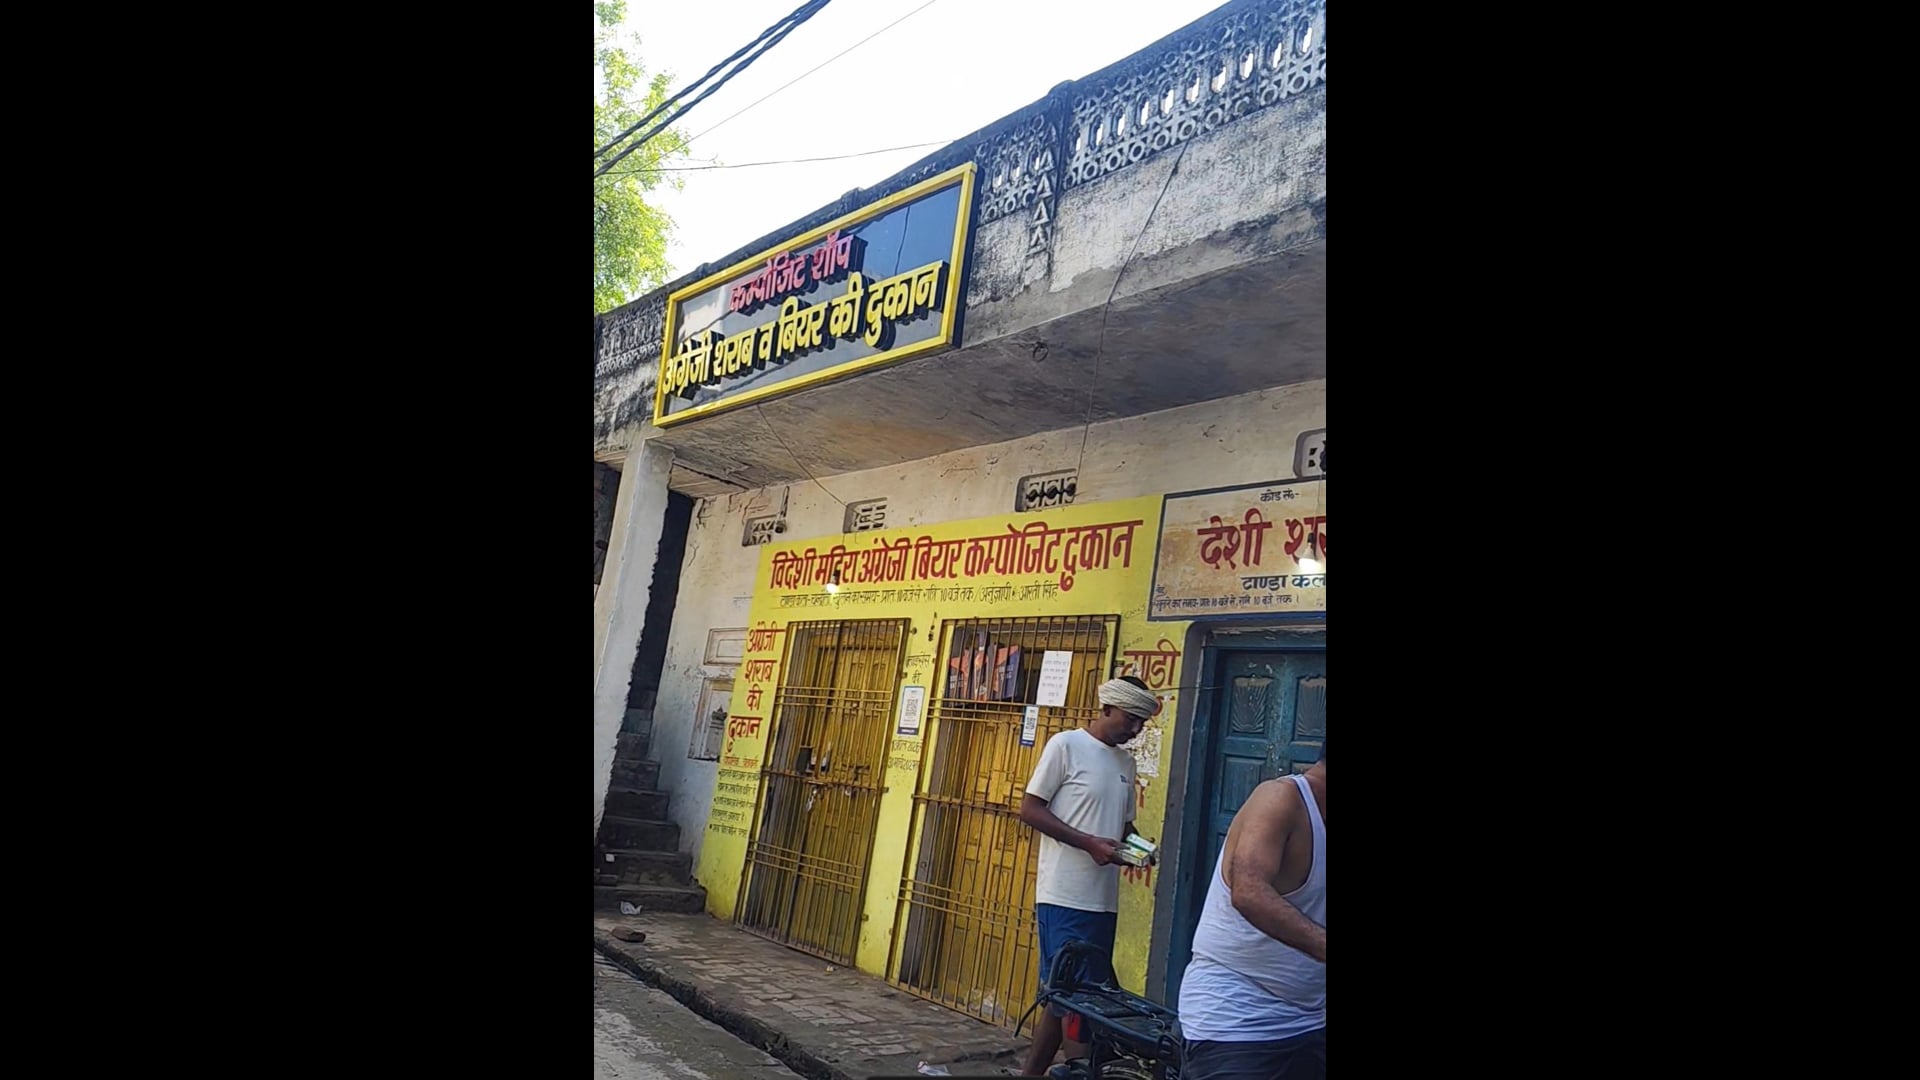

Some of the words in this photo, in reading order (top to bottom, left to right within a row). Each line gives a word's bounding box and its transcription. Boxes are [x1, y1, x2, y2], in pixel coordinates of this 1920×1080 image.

[730, 249, 808, 313] कम्पोजिट
[810, 228, 855, 281] शॉप
[663, 329, 713, 397] अंग्रेजी
[713, 327, 758, 376] शराब
[758, 320, 778, 361] व
[776, 295, 829, 358] बियर
[828, 272, 864, 336] की
[863, 259, 944, 348] दुकान
[1260, 489, 1281, 501] कोड
[1197, 508, 1272, 570] देशी
[770, 548, 817, 590] विदेशी
[815, 545, 860, 586] मदिरा
[858, 536, 912, 583] अंग्रेजी
[911, 535, 966, 579] बियर
[964, 521, 1066, 577] कम्पोजिट
[1060, 520, 1144, 591] दुकान
[1019, 580, 1041, 601] आरती
[1042, 579, 1060, 601] सिंह
[1241, 574, 1288, 590] टाण्डा
[746, 620, 786, 652] अंग्रेजी
[745, 659, 777, 683] शराब
[746, 683, 764, 711] की
[727, 715, 763, 752] दुकान
